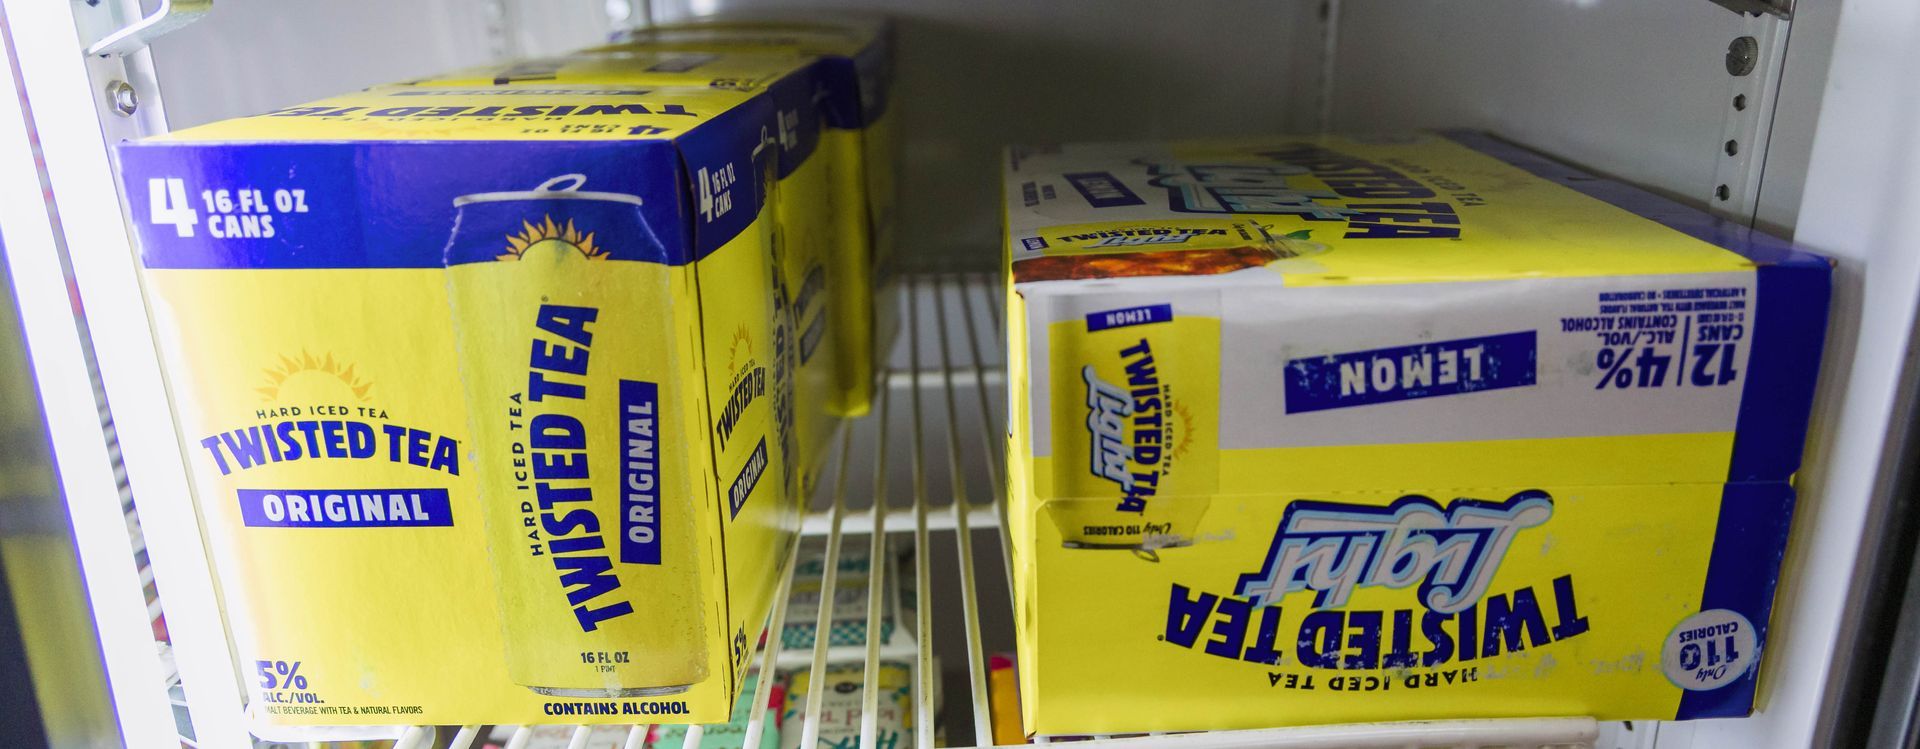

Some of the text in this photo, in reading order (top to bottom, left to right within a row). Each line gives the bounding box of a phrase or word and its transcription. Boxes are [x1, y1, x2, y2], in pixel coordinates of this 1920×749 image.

[366, 104, 698, 117] TWISTED
[149, 178, 309, 237] 4 16 FL OZ
[698, 162, 736, 223] 4 16 FL OZ
[715, 190, 732, 218] CANS
[208, 214, 275, 238] CANS
[1056, 229, 1167, 242] TWISTED
[1343, 201, 1462, 240] TEA
[1106, 309, 1152, 327] LEMON
[1561, 315, 1677, 332] CONTAINS ALCOHOL
[1697, 324, 1744, 342] CANS
[1597, 330, 1675, 346] ALC./VOL.
[528, 304, 599, 403] TEA
[1594, 347, 1671, 390] 4%
[1690, 343, 1738, 387] 12
[1340, 344, 1485, 397] LEMON
[257, 405, 389, 420] HARD ICED TEA
[716, 366, 766, 454] TWISTED TEA
[1119, 337, 1162, 465] TWISTED
[200, 420, 460, 477] TWISTED TEA
[1164, 422, 1173, 450] ICED
[509, 392, 544, 556] HARD ICED TEA
[628, 401, 655, 544] ORIGINAL
[733, 445, 765, 509] ORIGINAL
[1163, 455, 1172, 476] TEA
[262, 493, 430, 523] ORIGINAL
[529, 414, 635, 633] TWISTED
[1234, 489, 1554, 614] Light
[1165, 574, 1589, 670] TWISTED TEA
[1679, 621, 1739, 643] CALORIES
[581, 651, 630, 663] 16 FL OZ
[1679, 635, 1739, 671] 110
[255, 660, 308, 690] 5%
[1268, 667, 1478, 691] HARD ICED TEA
[1695, 664, 1727, 682] Only
[263, 692, 325, 704] ALC./VOL.
[283, 706, 318, 715] BEVERAGE
[319, 706, 337, 715] WITH
[339, 706, 352, 715] TEA
[353, 706, 359, 715] &
[360, 706, 391, 715] NATURAL
[392, 705, 423, 714] FLAVORS
[543, 701, 690, 716] CONTAINS ALCOHOL
